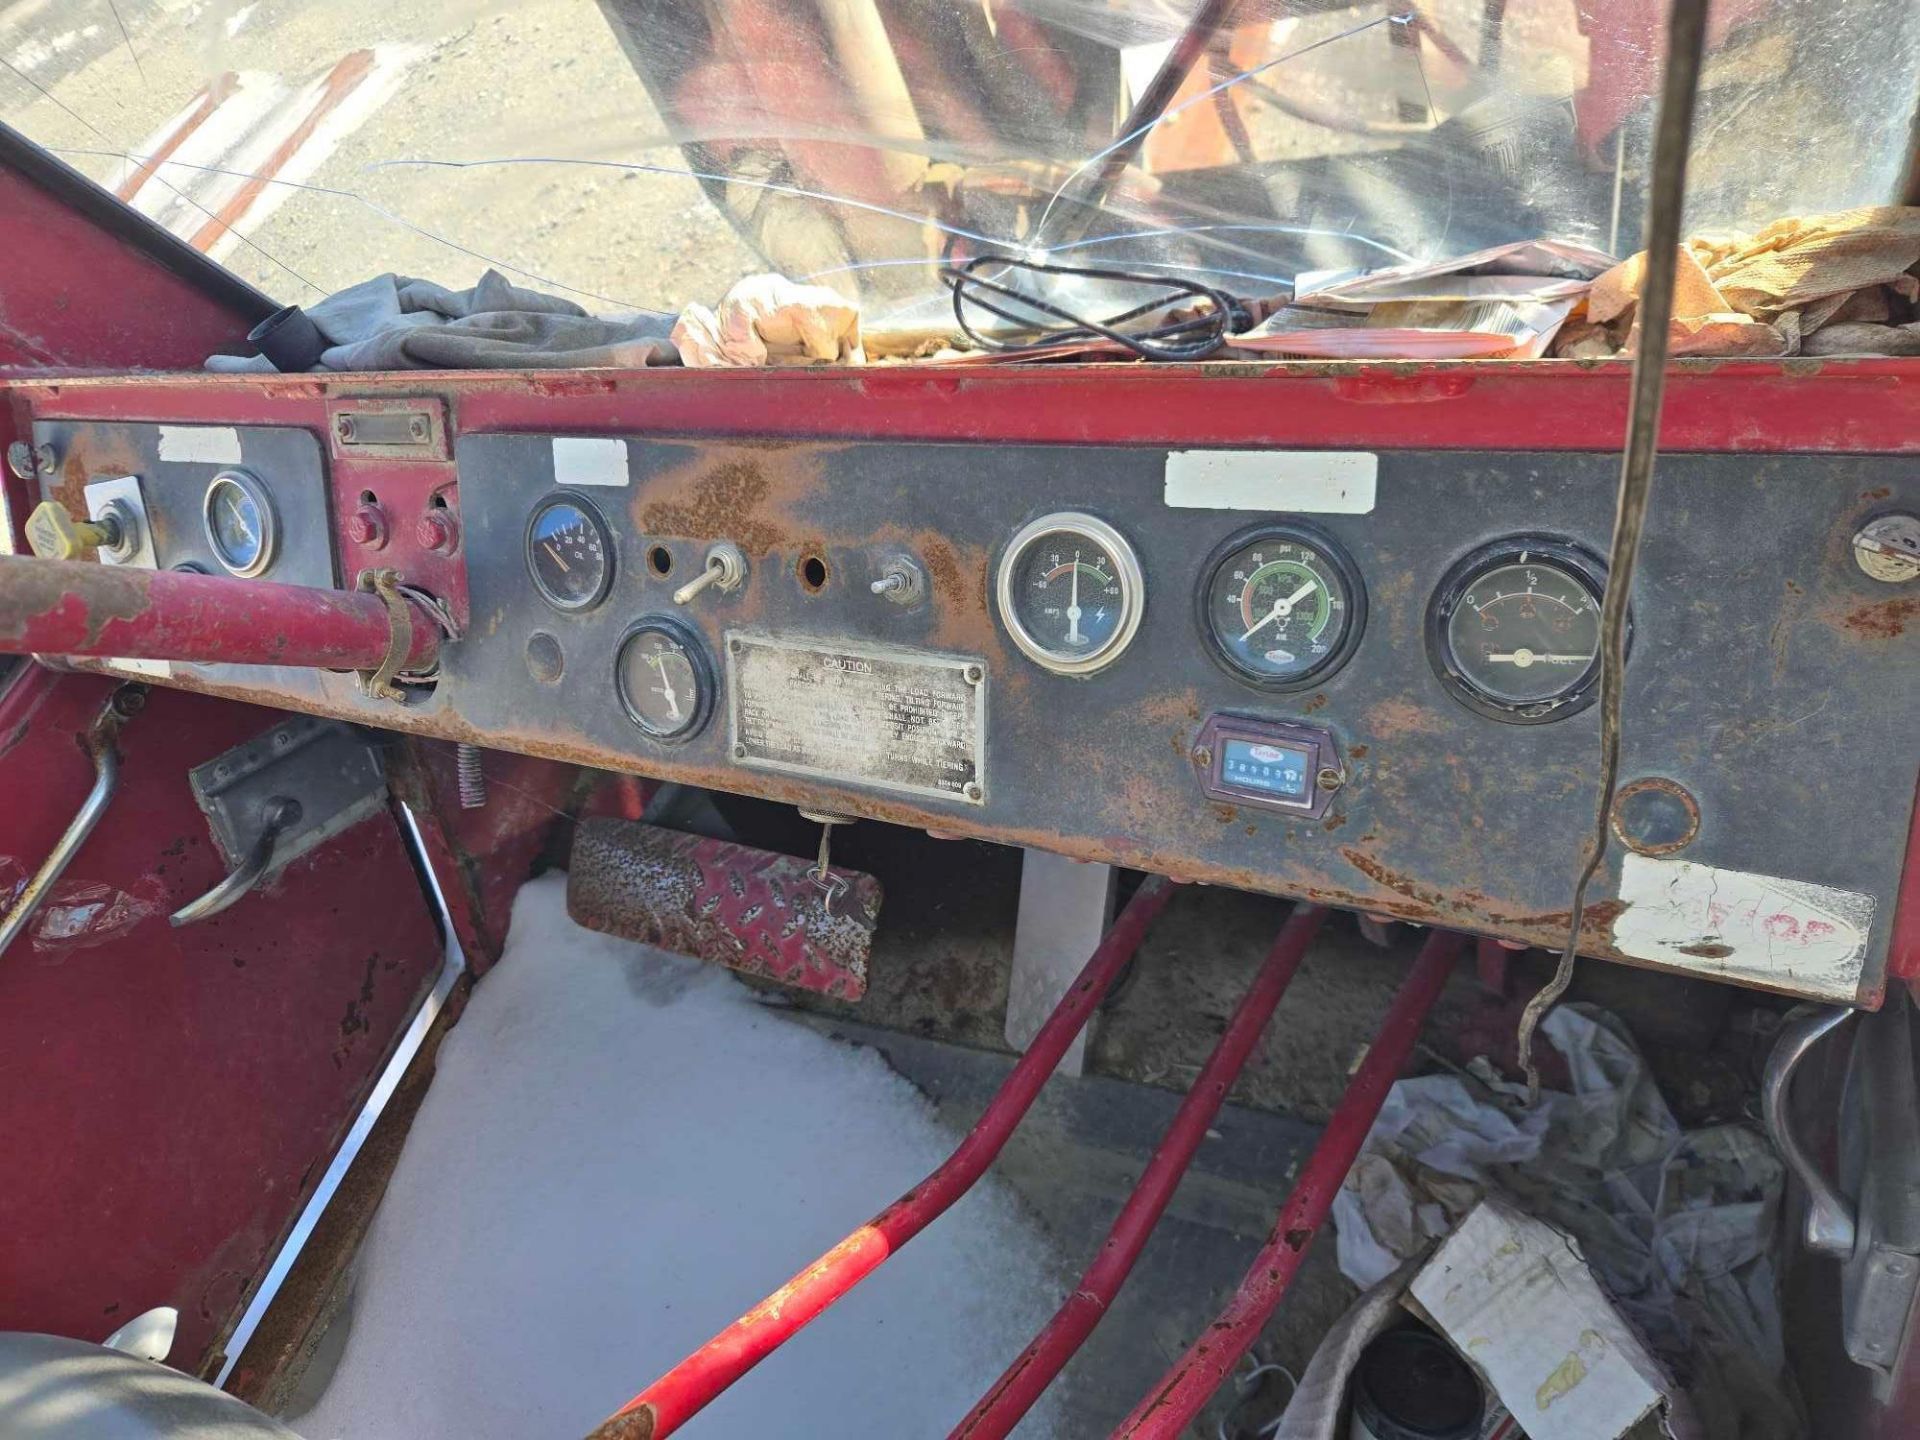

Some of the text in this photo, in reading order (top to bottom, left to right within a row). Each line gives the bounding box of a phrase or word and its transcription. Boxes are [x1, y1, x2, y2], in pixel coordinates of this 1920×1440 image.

[565, 536, 573, 544] 20
[556, 543, 561, 551] 0
[1075, 550, 1080, 559] 0
[1466, 594, 1475, 605] 0
[823, 656, 873, 673] CAUTION
